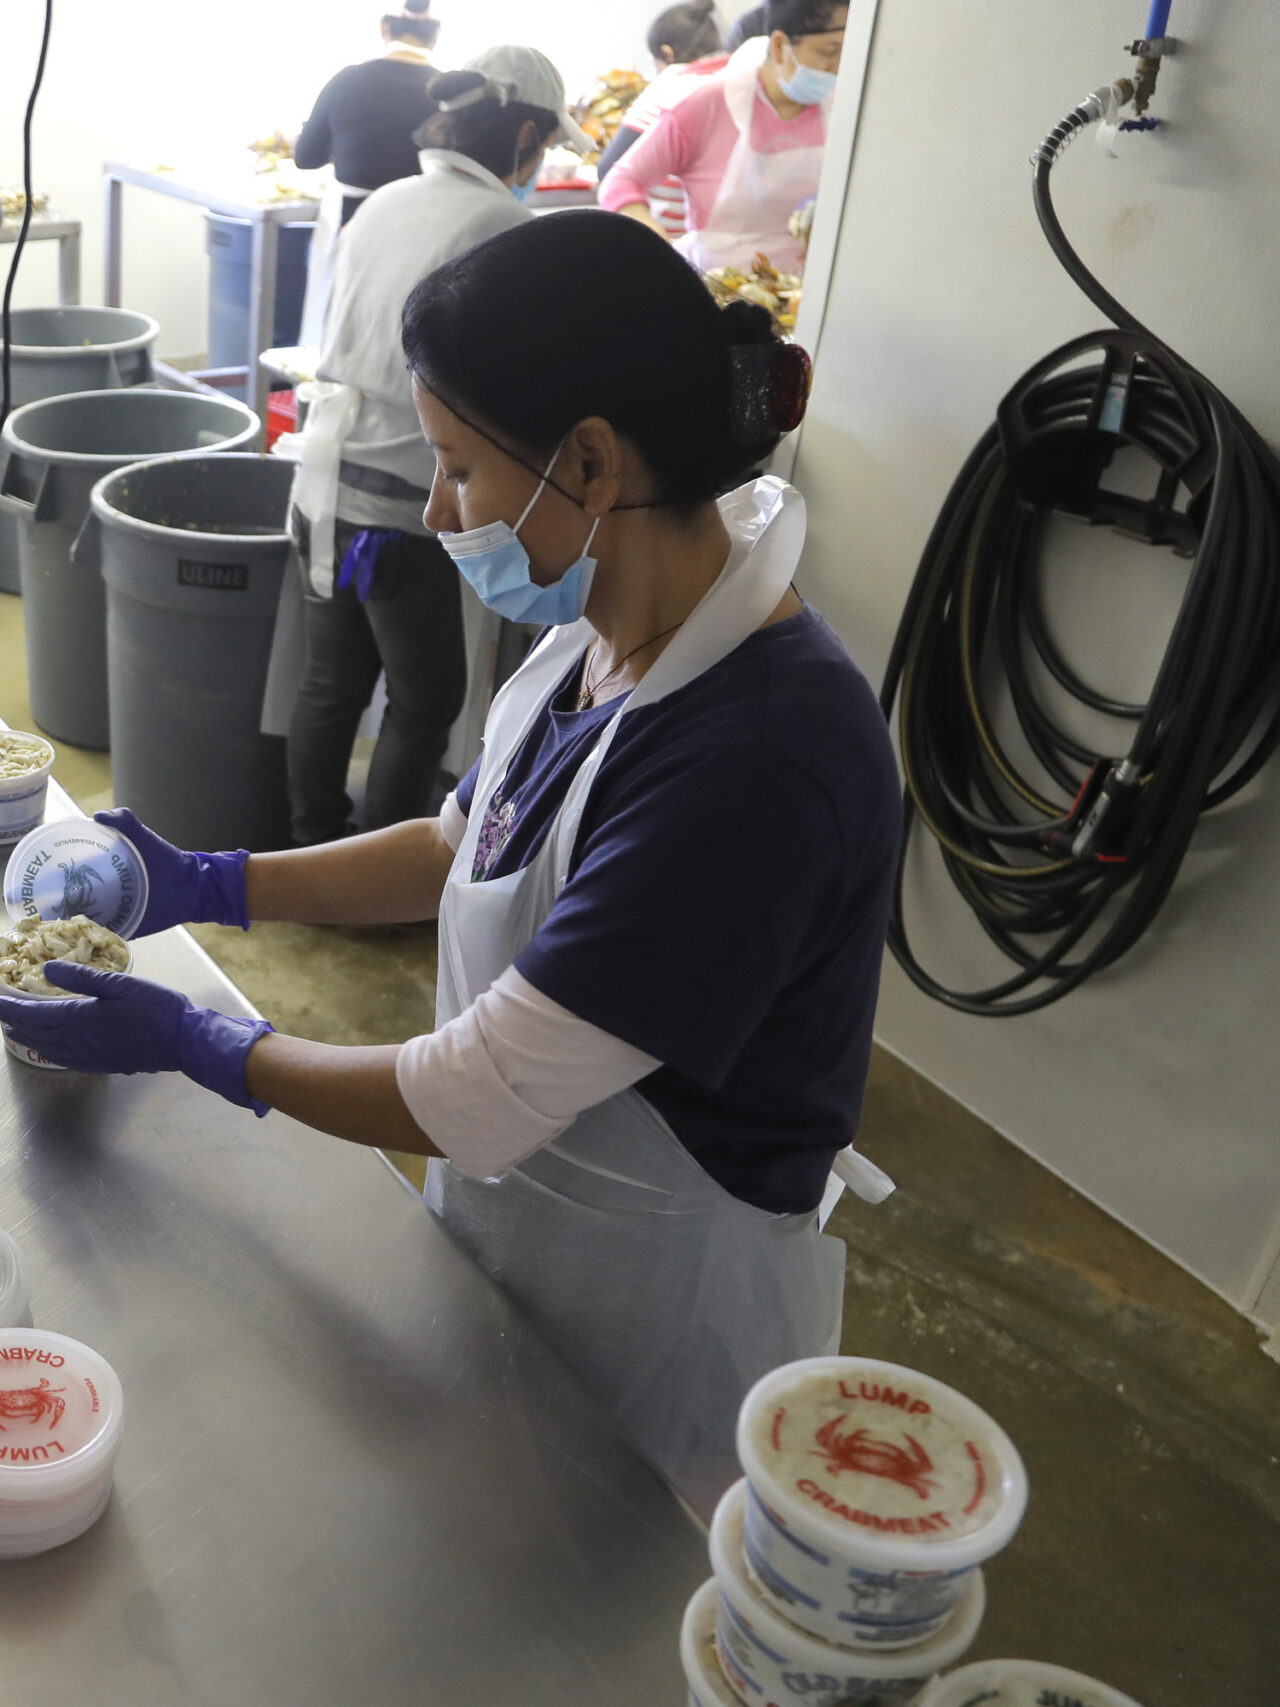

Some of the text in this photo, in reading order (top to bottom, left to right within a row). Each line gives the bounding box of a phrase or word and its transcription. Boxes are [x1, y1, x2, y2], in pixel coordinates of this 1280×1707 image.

[182, 563, 246, 587] ULINE
[838, 1380, 931, 1415] LUMP
[797, 1479, 951, 1535] CRABMEAT
